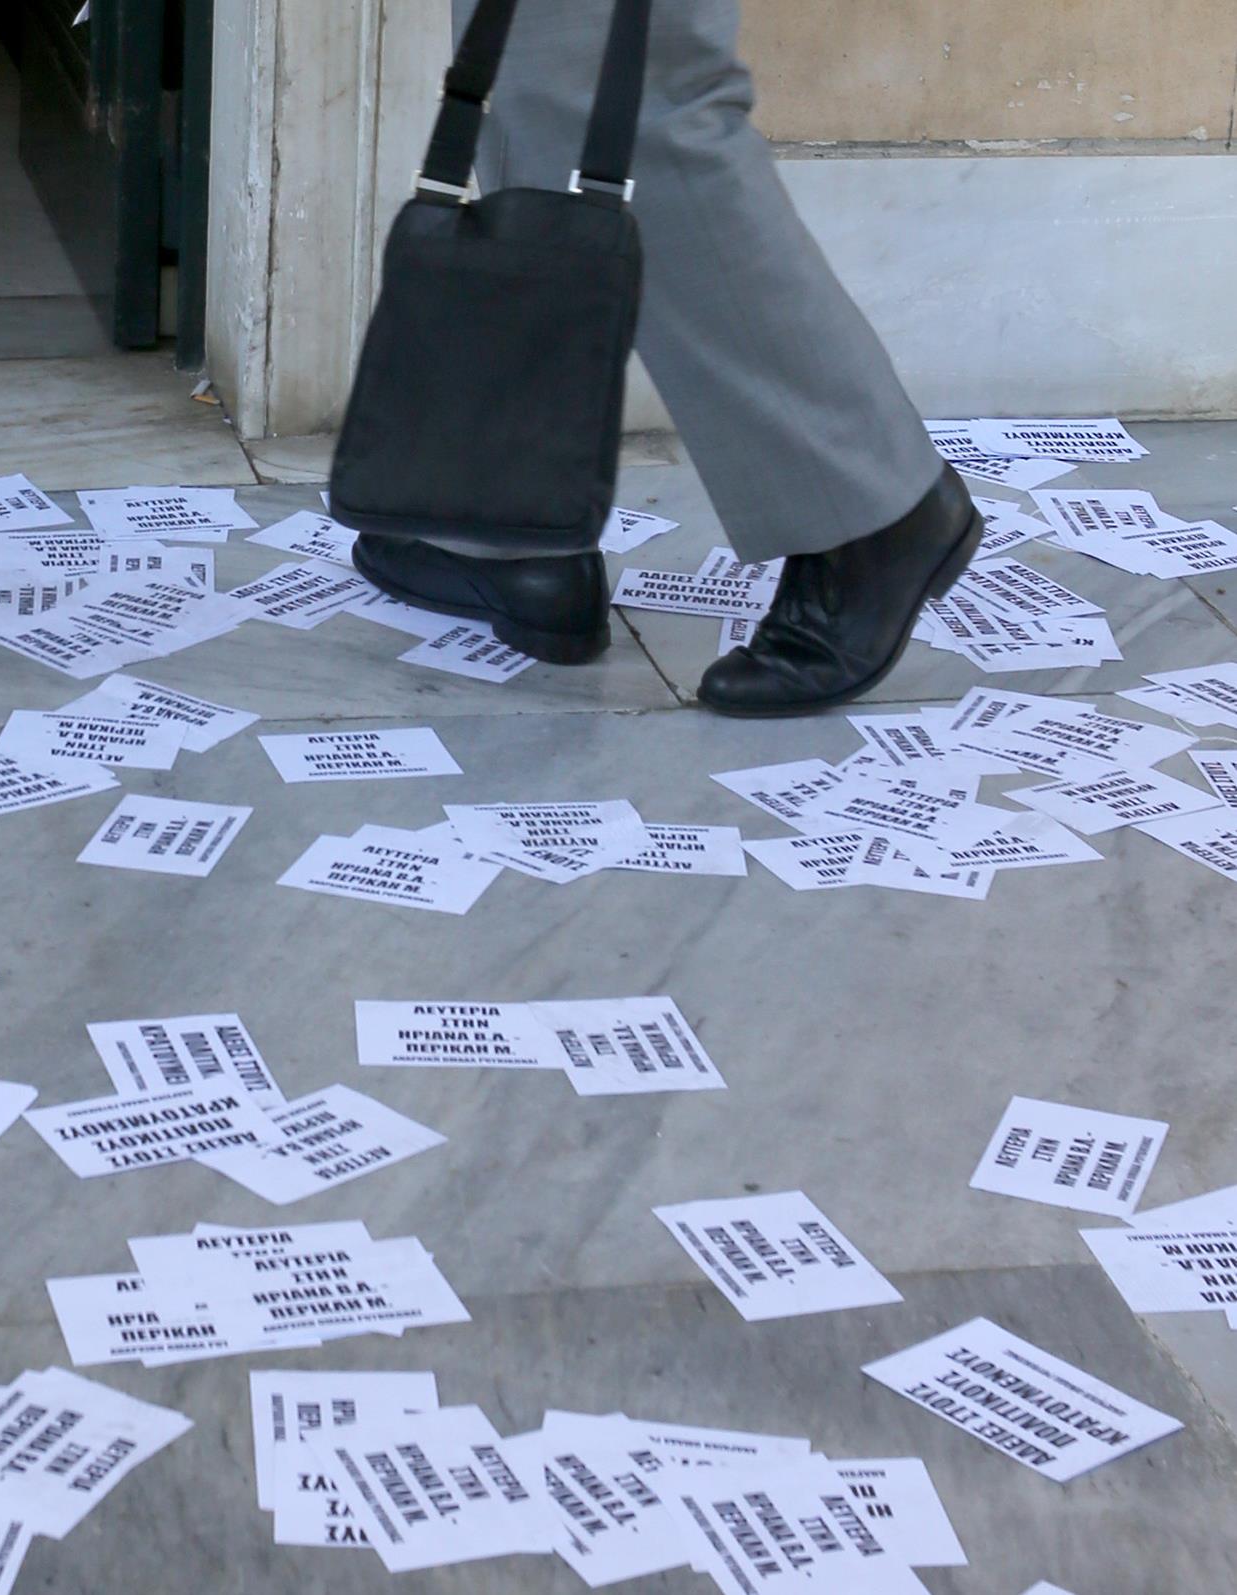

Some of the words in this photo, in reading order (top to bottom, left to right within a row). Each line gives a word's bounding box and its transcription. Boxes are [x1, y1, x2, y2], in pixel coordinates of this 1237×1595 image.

[77, 722, 145, 736] ΠΕΡΙΚΛΗ
[65, 741, 106, 751] ΣΤΗΝ
[88, 734, 146, 746] ΗΡΙΑΝΑ
[308, 734, 380, 743] ΛΕΥΤΕΡΙΑ
[335, 742, 376, 751] ΣΤΗΝ
[51, 748, 124, 762] ΛΕΥΤΕΡΙΑ
[304, 753, 363, 761] ΗΡΙΑΝΑ
[315, 761, 384, 770] ΠΕΡΙΚΛΗ
[1075, 777, 1136, 794] ΠΕΡΙΚΛΗ
[1103, 784, 1157, 798] ΗΡΙΑΝΑ
[1107, 797, 1147, 810] ΣΤΗΝ
[1116, 802, 1181, 819] ΛΕΥΤΕΡΙΑ
[540, 818, 602, 826] ΗΡΙΑΝΑ
[527, 828, 570, 836] ΣΤΗΝ
[521, 837, 598, 847] ΛΕΥΤΕΡΙΑ
[363, 846, 439, 865] ΛΕΥΤΕΡΙΑ
[331, 862, 393, 878] ΗΡΙΑΝΑ
[377, 858, 422, 872] ΣΤΗΝ
[328, 872, 401, 890] ΠΕΡΙΚΛΗ
[414, 1006, 500, 1016] ΛΕΥΤΕΡΙΑ
[442, 1018, 489, 1028] ΣΤΗΝ
[398, 1030, 469, 1041] ΗΡΙΑΝΑ
[406, 1043, 488, 1054] ΠΕΡΙΚΛΗ
[58, 1096, 239, 1140] ΚΡΑΤΟΥΜΕΝΟΥΣ
[96, 1117, 233, 1152] ΠΟΛΙΤΙΚΟΥΣ
[185, 1132, 257, 1154] ΑΔΕΙΕΣ
[995, 1127, 1032, 1168] ΛΕΥΤΕΡΙΑ
[1031, 1137, 1060, 1162] ΣΤΗΝ
[110, 1146, 178, 1168] ΣΤΟΥΣ
[1054, 1154, 1087, 1187] ΗΡΙΑΝΑ
[1087, 1151, 1122, 1190] ΠΕΡΙΚΛΗ
[196, 1231, 294, 1251] ΛΕΥΤΕΡΙΑ
[254, 1252, 350, 1271] ΛΕΥΤΕΡΙΑ
[293, 1267, 347, 1283] ΣΤΗΝ
[253, 1286, 333, 1304] ΗΡΙΑΝΑ
[270, 1299, 362, 1319] ΠΕΡΙΚΛΗ
[904, 1382, 981, 1424] ΣΤΟΥΣ
[945, 1348, 1130, 1446] ΚΡΑΤΟΥΜΕΝΟΥΣ
[935, 1370, 1078, 1448] ΠΟΛΙΤΙΚΟΥΣ
[972, 1421, 1057, 1466] ΑΔΕΙΕΣ
